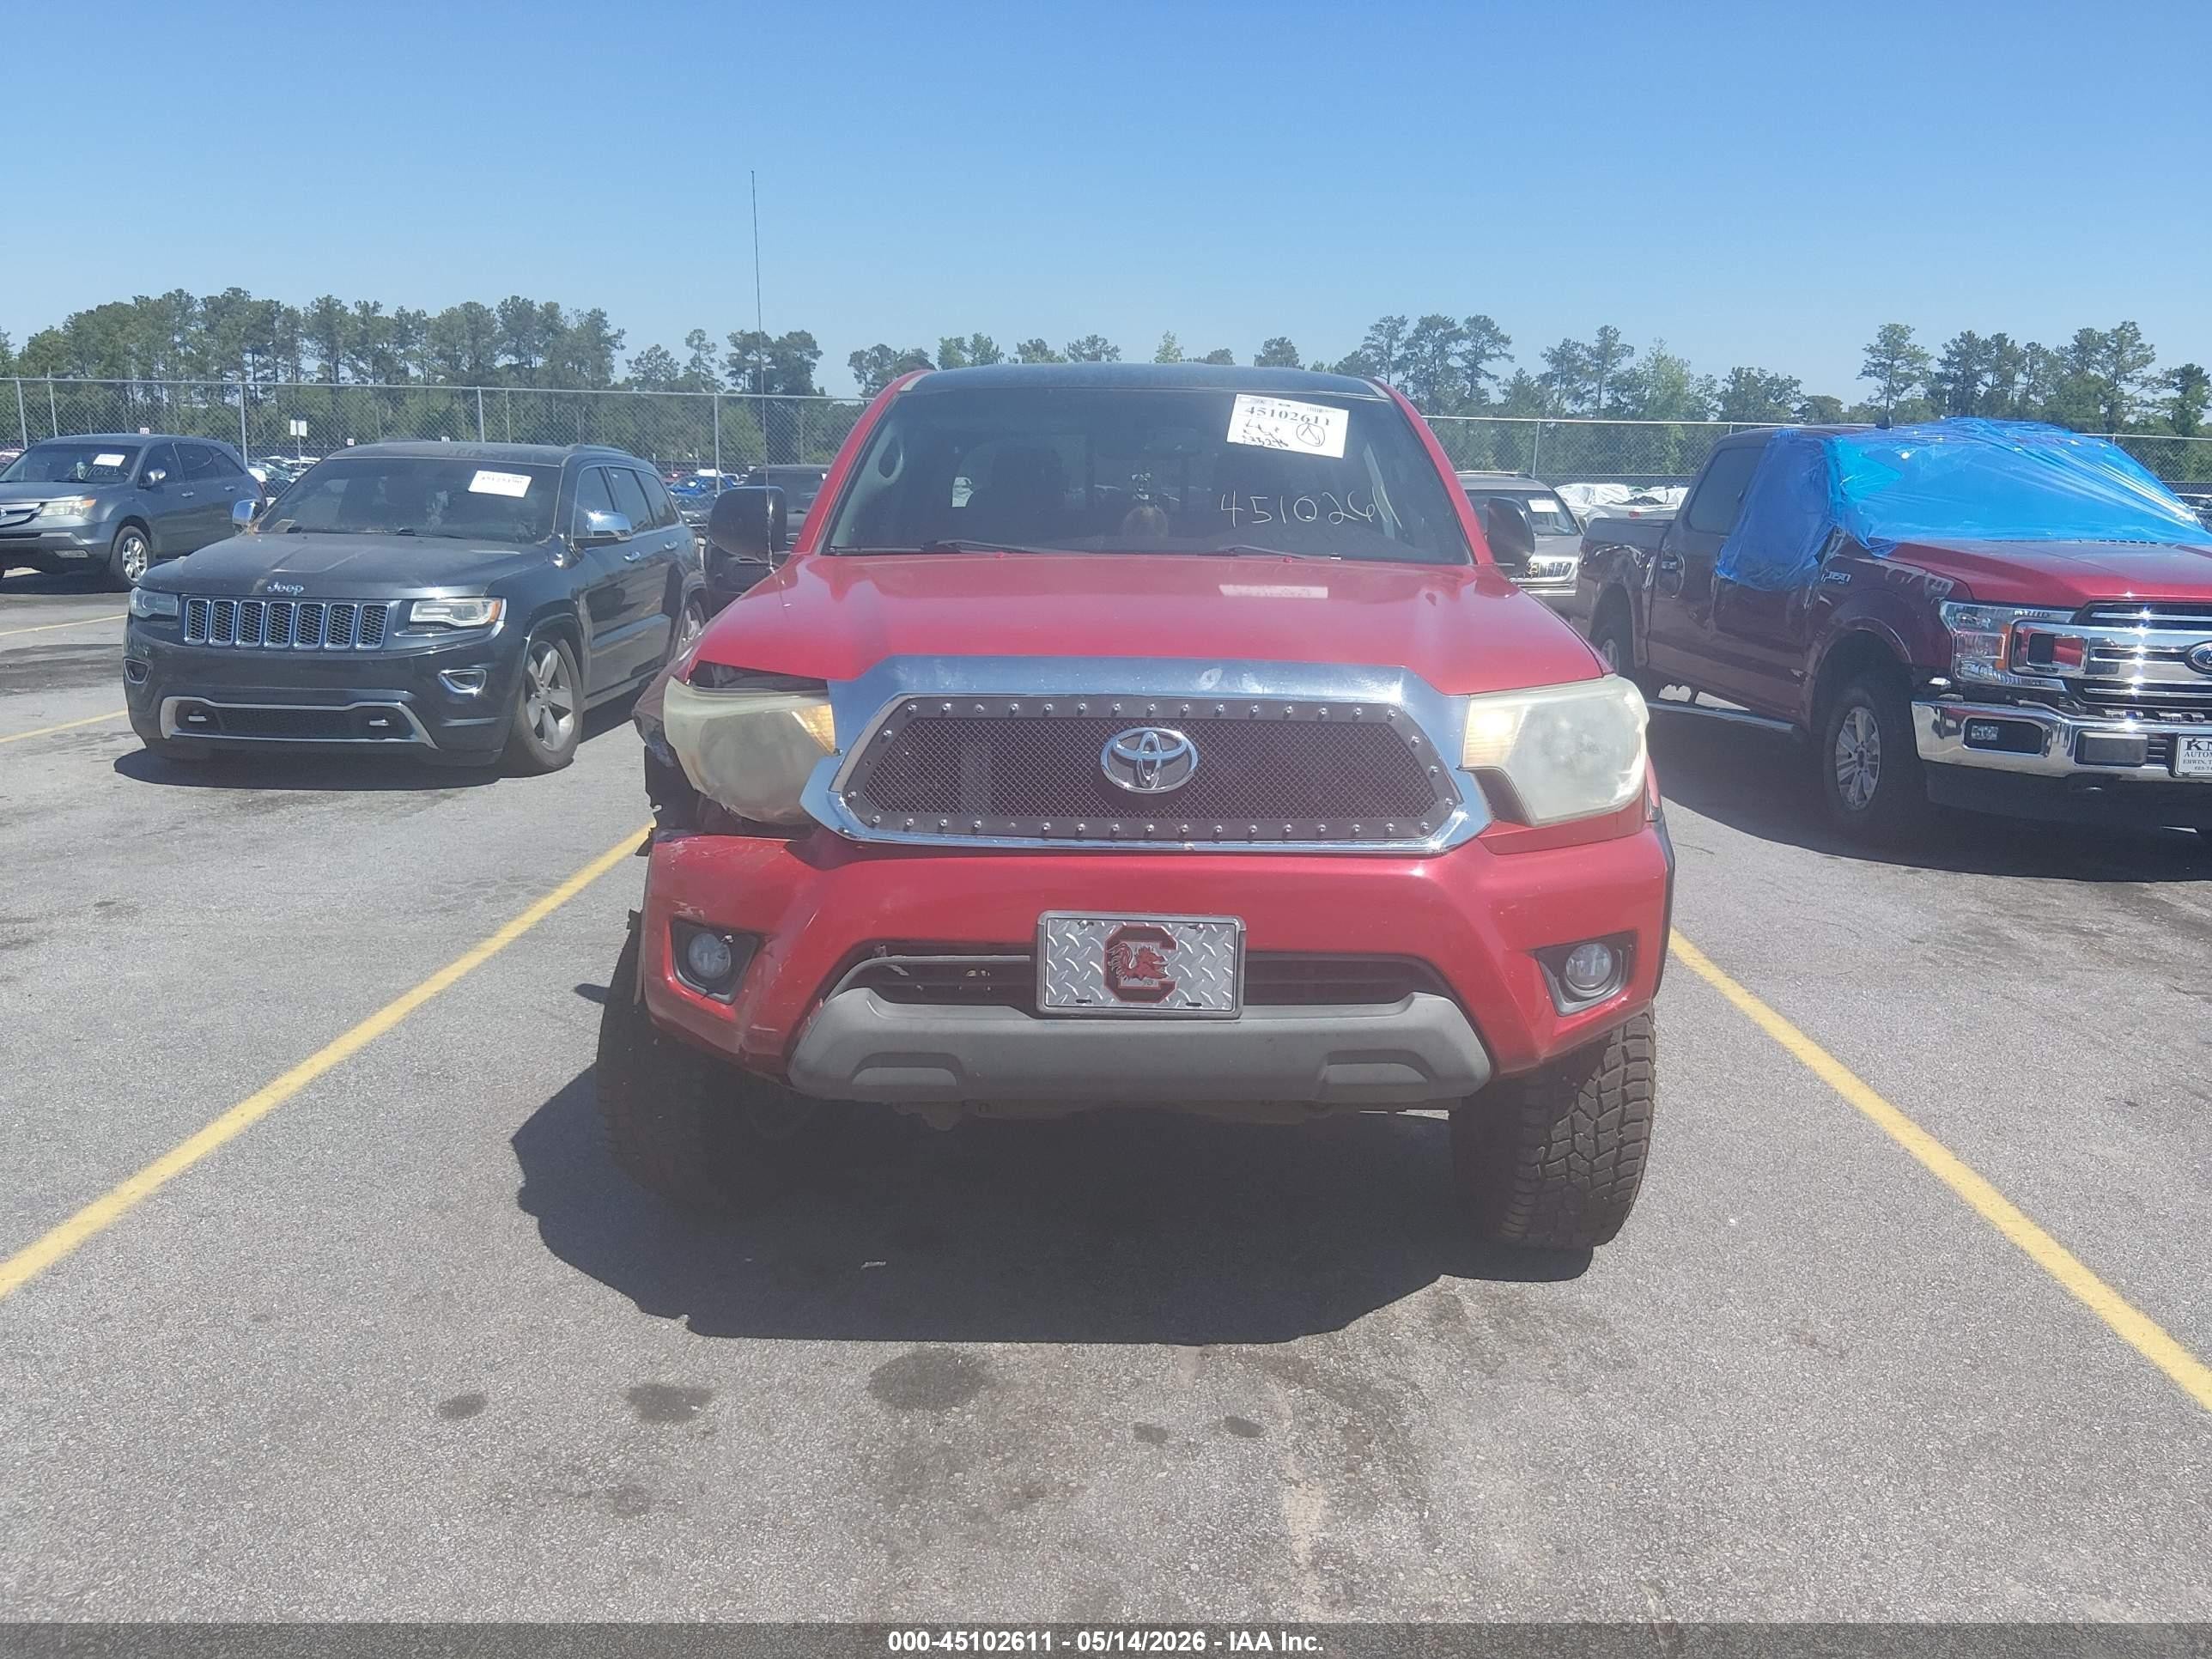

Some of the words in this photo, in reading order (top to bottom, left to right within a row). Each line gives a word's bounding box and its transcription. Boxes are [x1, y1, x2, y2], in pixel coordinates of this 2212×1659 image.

[1244, 406, 1330, 426] 45102611
[1221, 489, 1402, 529] 45102611
[267, 581, 305, 596] Jeep
